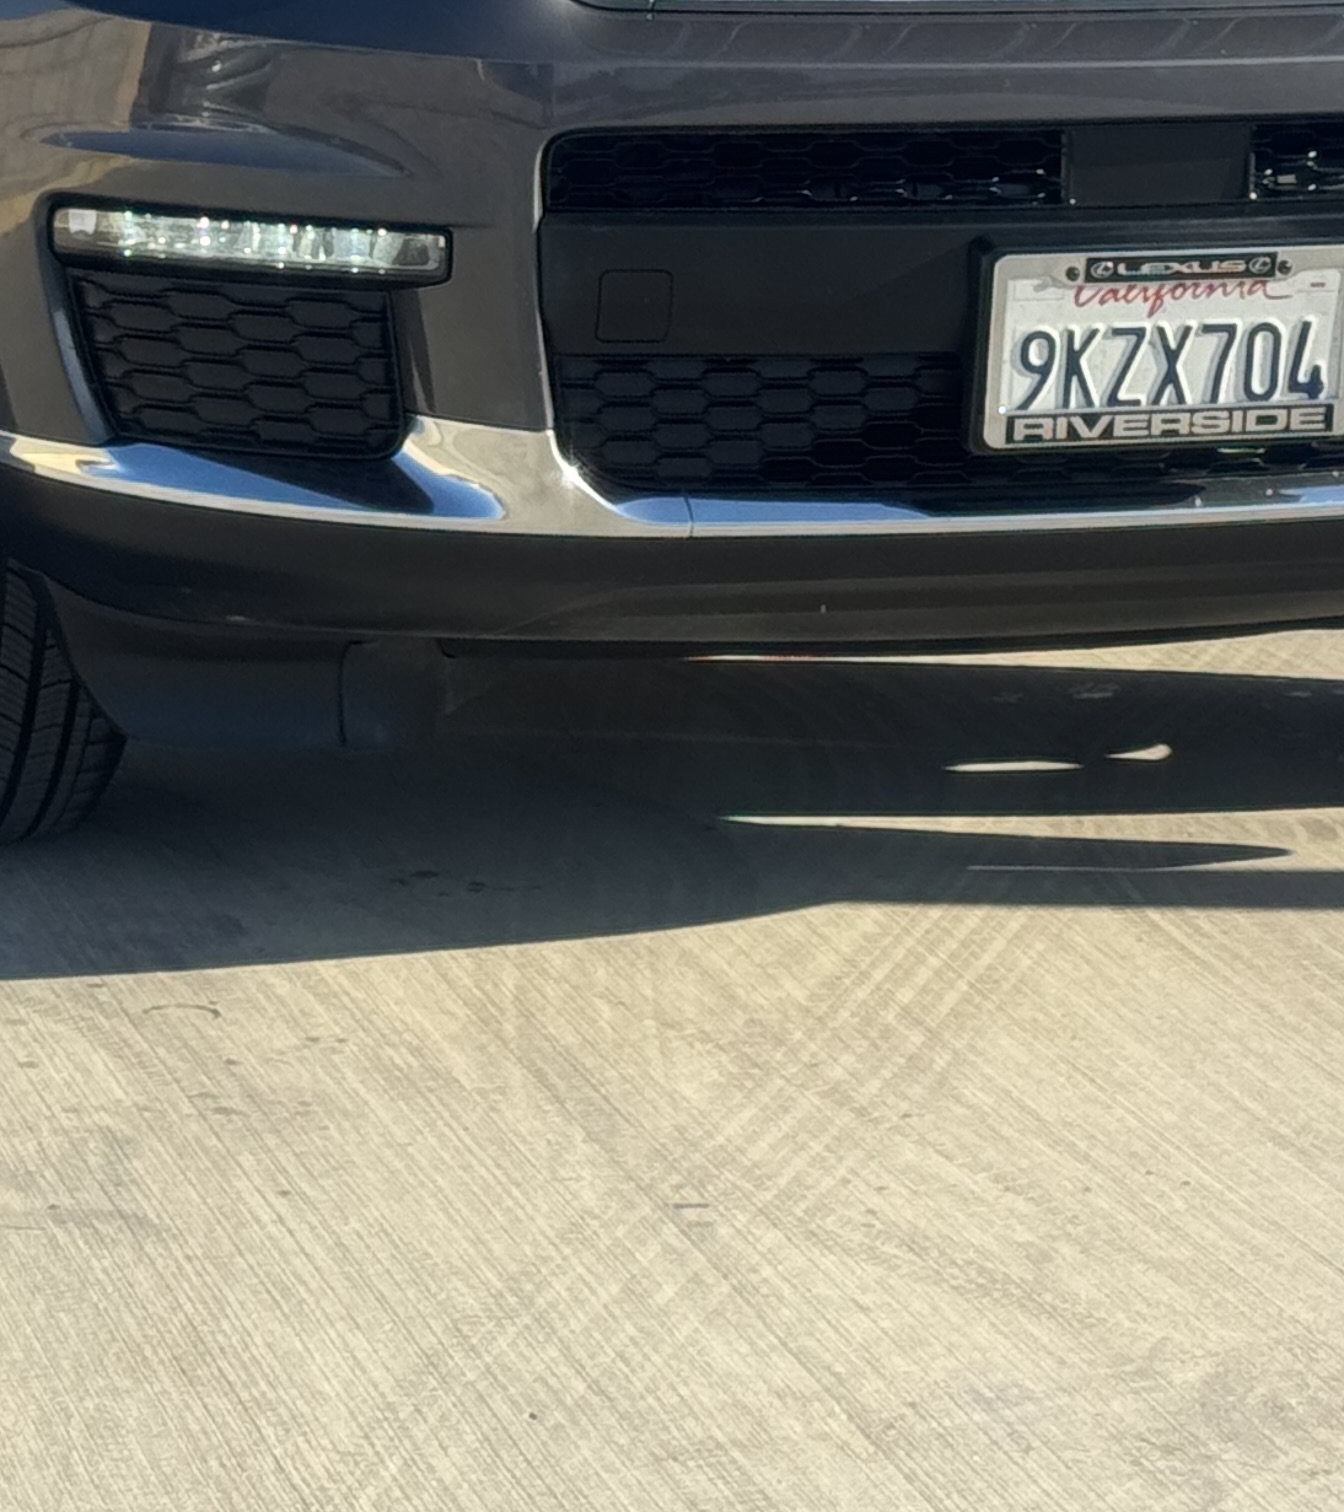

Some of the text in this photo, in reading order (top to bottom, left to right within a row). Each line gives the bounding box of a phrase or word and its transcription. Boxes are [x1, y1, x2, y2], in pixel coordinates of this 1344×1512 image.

[1117, 259, 1247, 276] LEXUS
[1018, 320, 1325, 410] 9KZX704
[1014, 408, 1328, 442] RIVERSIDE
